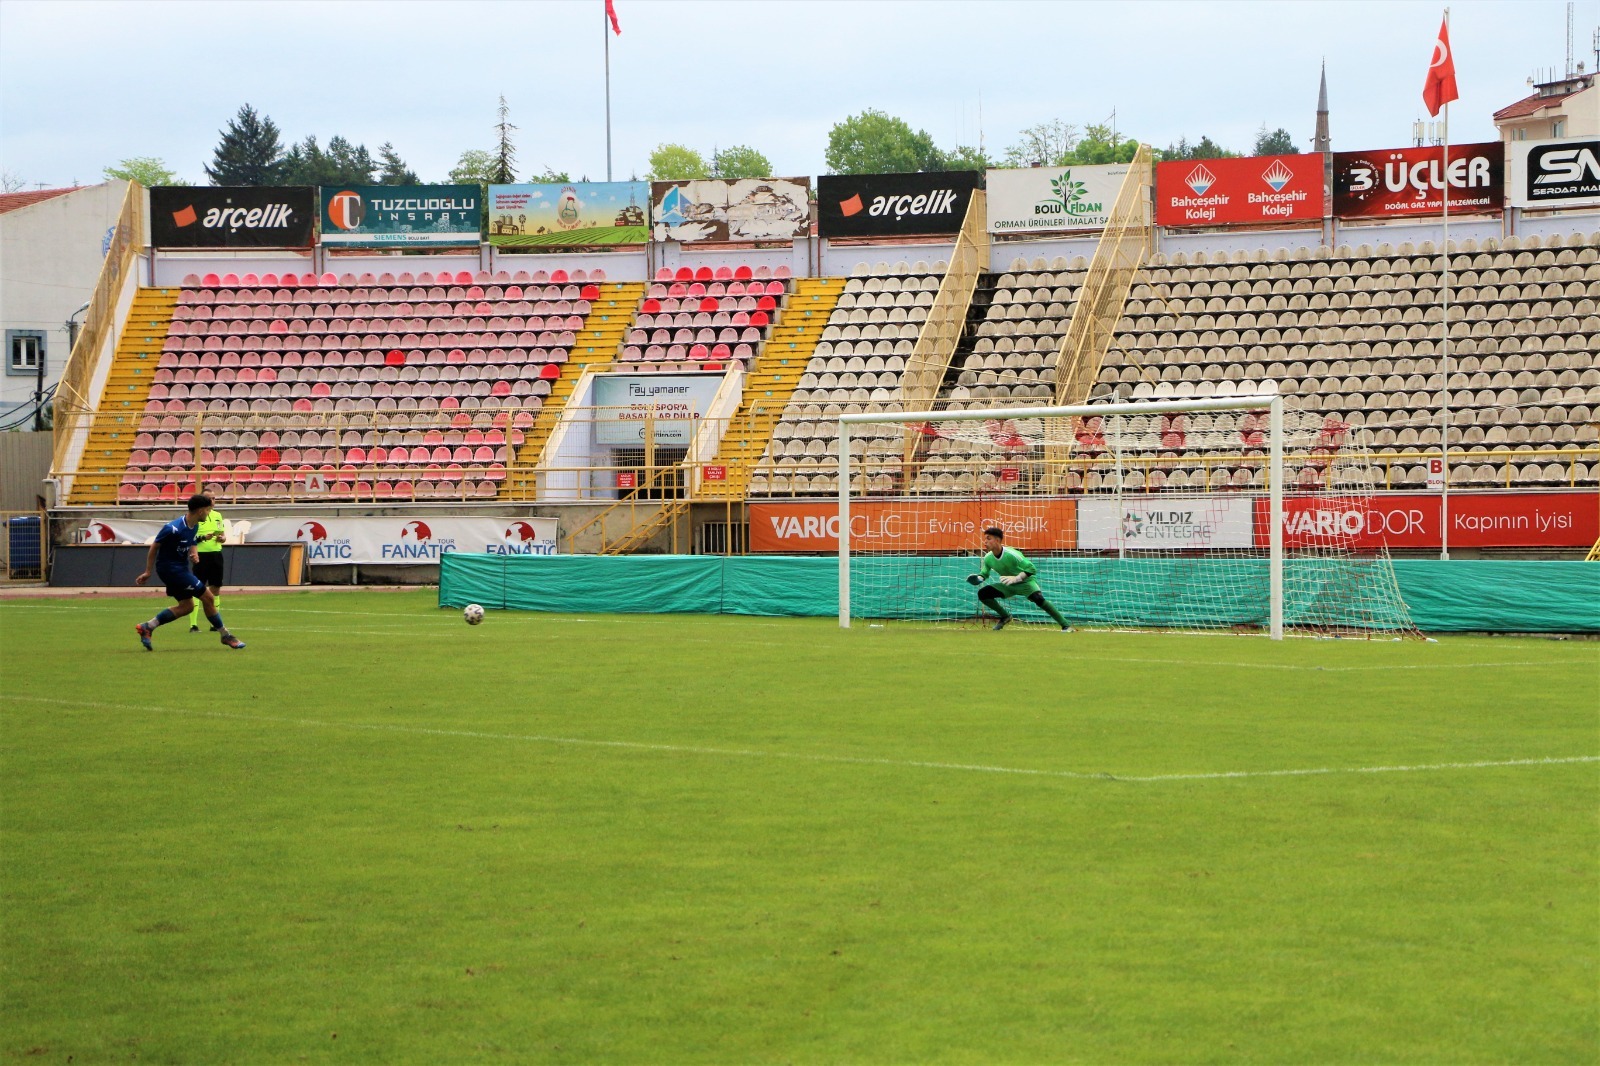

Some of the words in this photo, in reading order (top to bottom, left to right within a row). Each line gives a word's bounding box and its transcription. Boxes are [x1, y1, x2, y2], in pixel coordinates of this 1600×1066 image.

[1385, 153, 1490, 200] ÜÇLER
[1248, 190, 1307, 204] Bahçeşehir
[1532, 186, 1578, 196] SERDAR
[868, 189, 957, 221] arçelik
[1171, 194, 1230, 208] Bahçeşehir
[1385, 202, 1409, 210] DOĞAL
[1034, 204, 1061, 214] BOLU
[1070, 202, 1102, 214] FİDAN
[1185, 208, 1216, 220] Koleji
[1262, 204, 1293, 217] Koleji
[203, 203, 293, 234] arçelik
[994, 220, 1026, 229] ORMAN
[1028, 218, 1066, 228] ÜRÜNLERİ
[1067, 216, 1097, 226] İMALAT
[629, 383, 646, 396] Fay
[646, 386, 690, 396] yamaner
[1430, 460, 1442, 474] B
[310, 476, 320, 490] A
[1146, 512, 1194, 524] YILDIZ
[1454, 513, 1528, 532] Kapının
[1535, 509, 1572, 532] İyisi
[928, 518, 975, 534] Evine
[980, 516, 1048, 533] Güzellik
[1145, 526, 1211, 538] ENTEGRE
